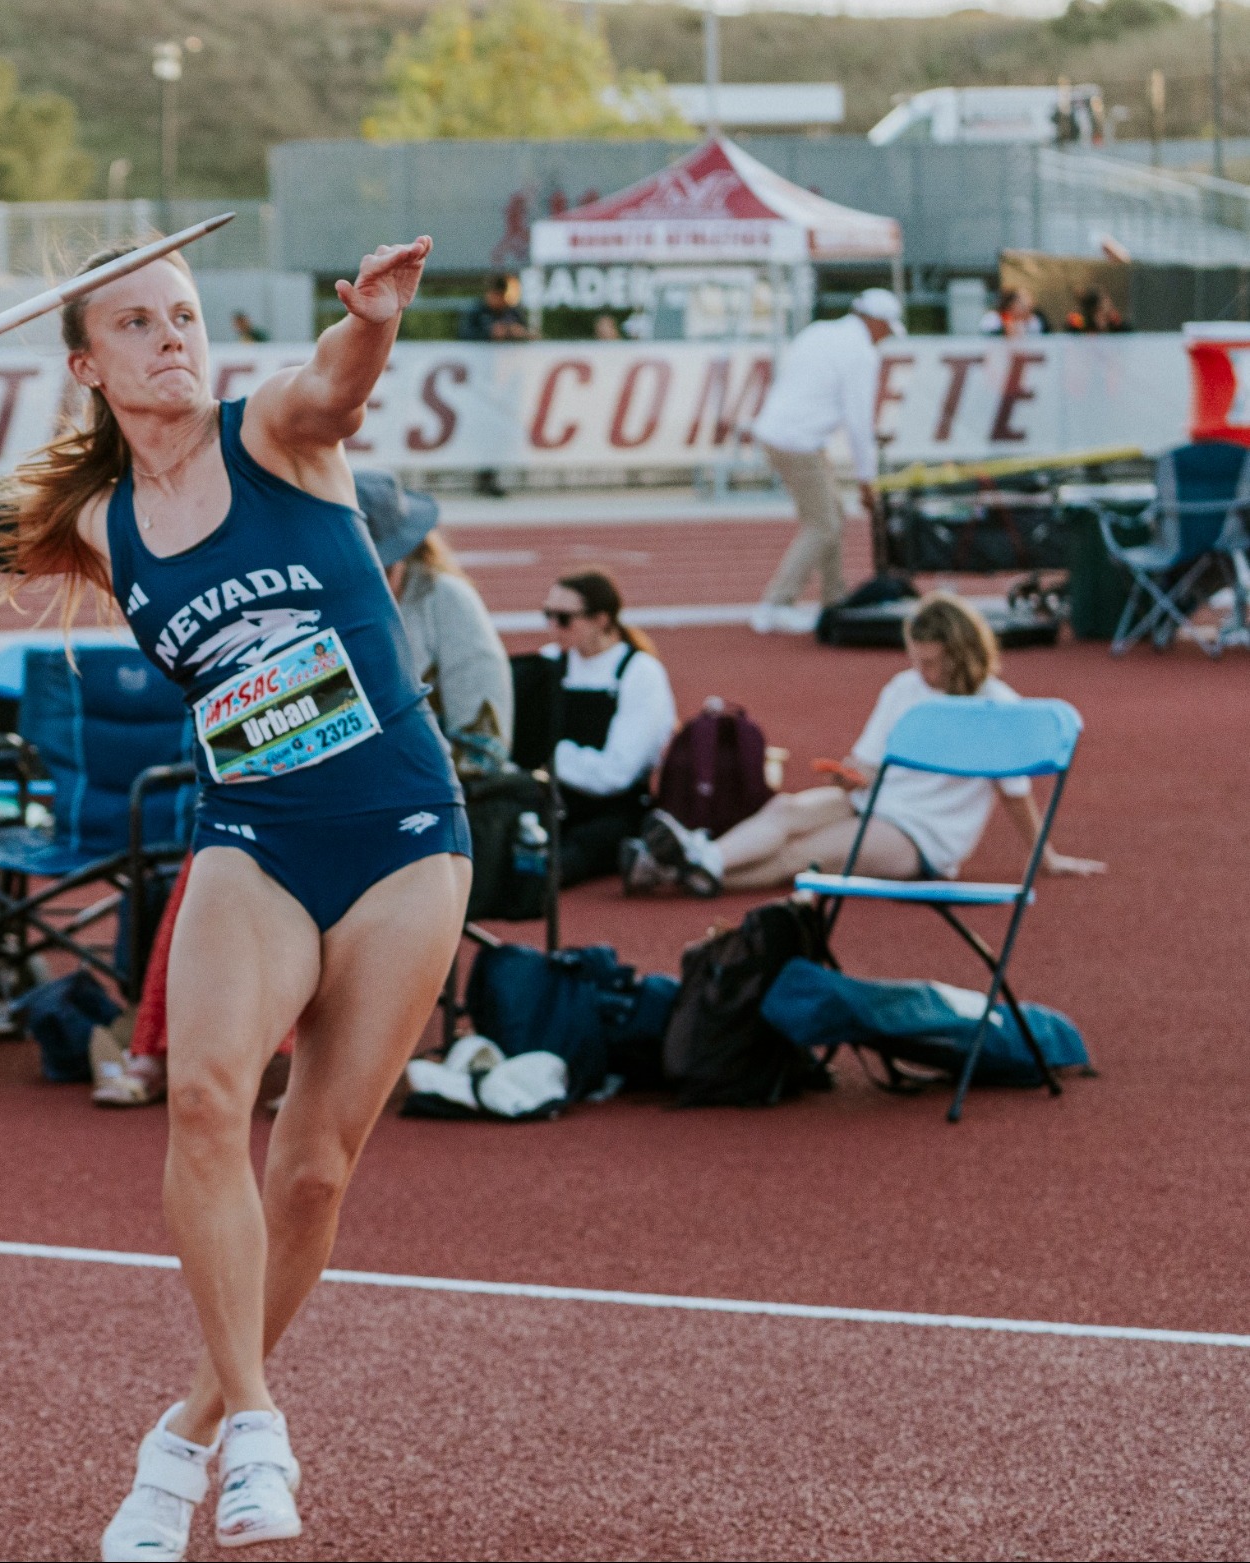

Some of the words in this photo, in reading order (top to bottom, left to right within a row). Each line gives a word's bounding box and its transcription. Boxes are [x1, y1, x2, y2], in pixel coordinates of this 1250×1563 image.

[528, 352, 1047, 450] COMETE
[155, 564, 324, 670] NEVADA
[242, 694, 320, 748] Urban
[316, 711, 363, 748] 2325
